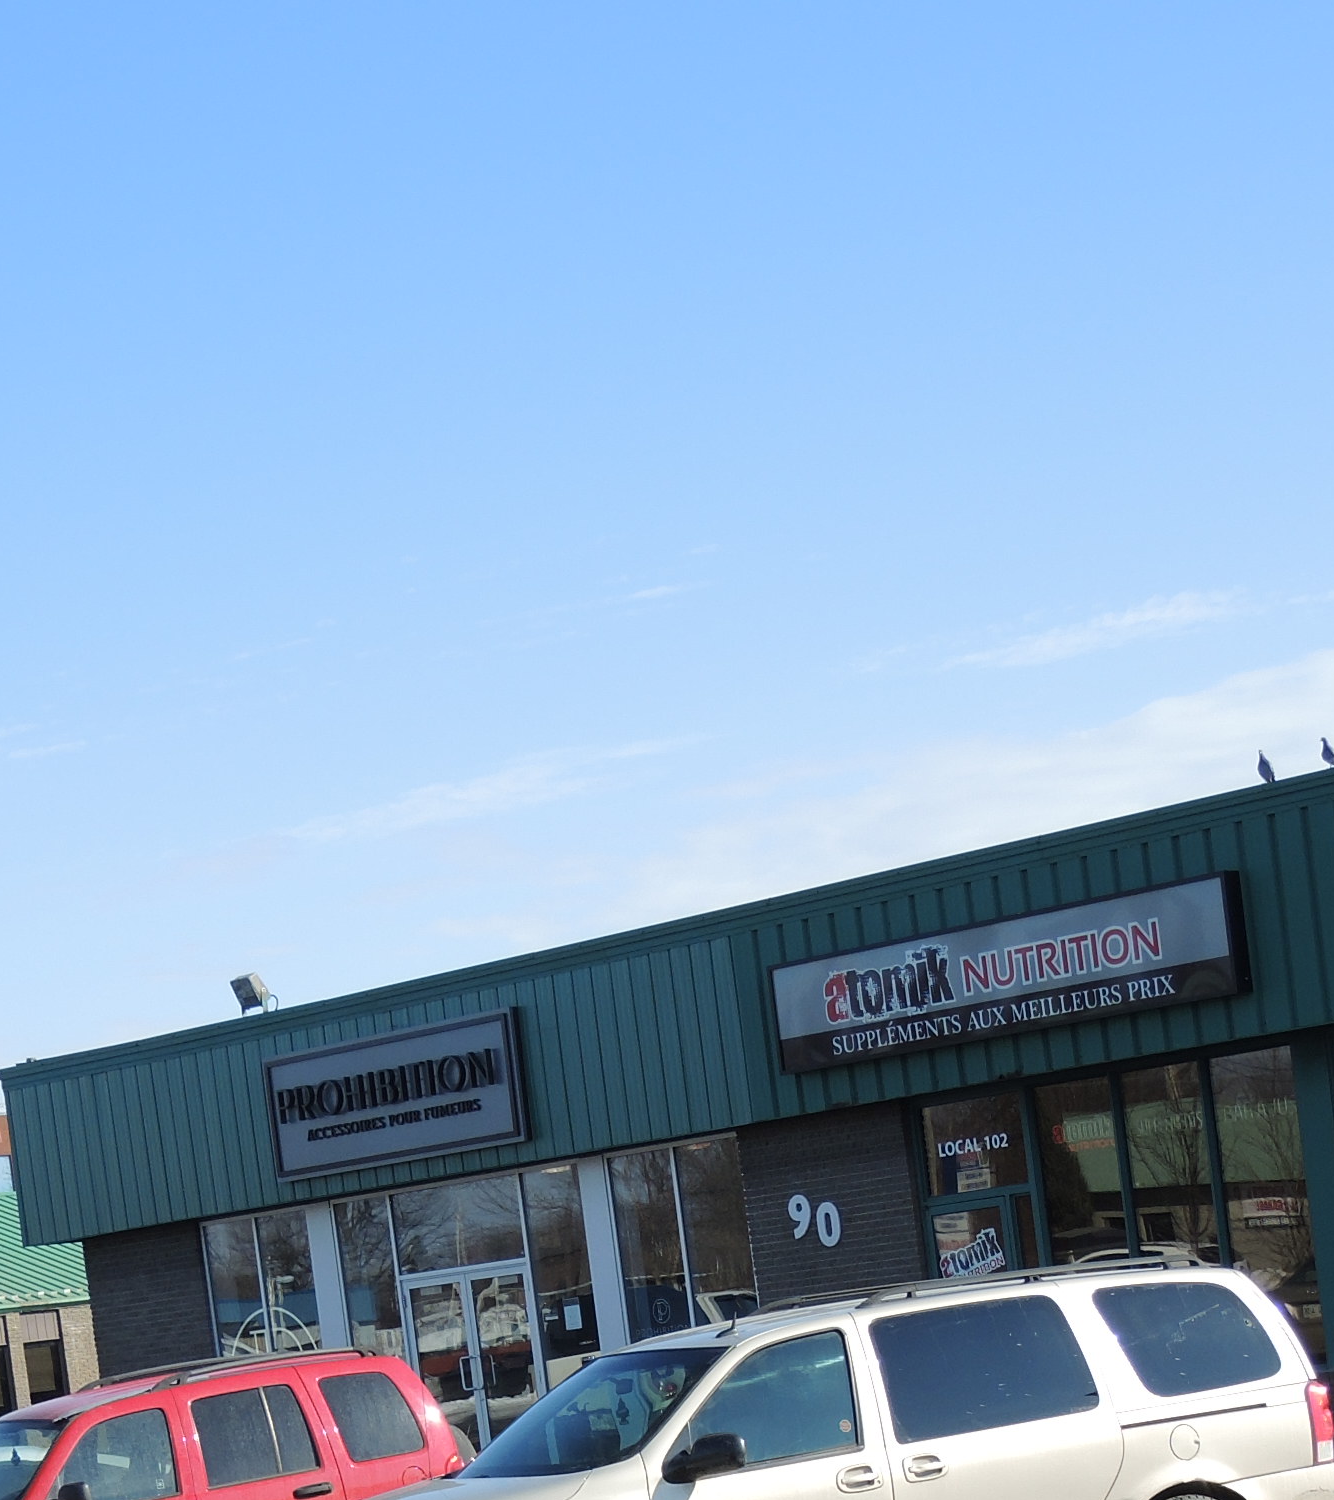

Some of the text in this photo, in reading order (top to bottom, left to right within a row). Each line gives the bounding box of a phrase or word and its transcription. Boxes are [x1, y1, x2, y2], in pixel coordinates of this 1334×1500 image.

[960, 917, 1164, 997] NUTRITION
[832, 973, 1177, 1056] SUPPLÉMENTS AUX MEILLEURS PRIX
[277, 1047, 502, 1125] PROHIBITION
[307, 1098, 482, 1142] ACCESSOIRES POUR FUMEURS
[938, 1132, 1009, 1158] LOCAL 102
[788, 1194, 842, 1247] 90
